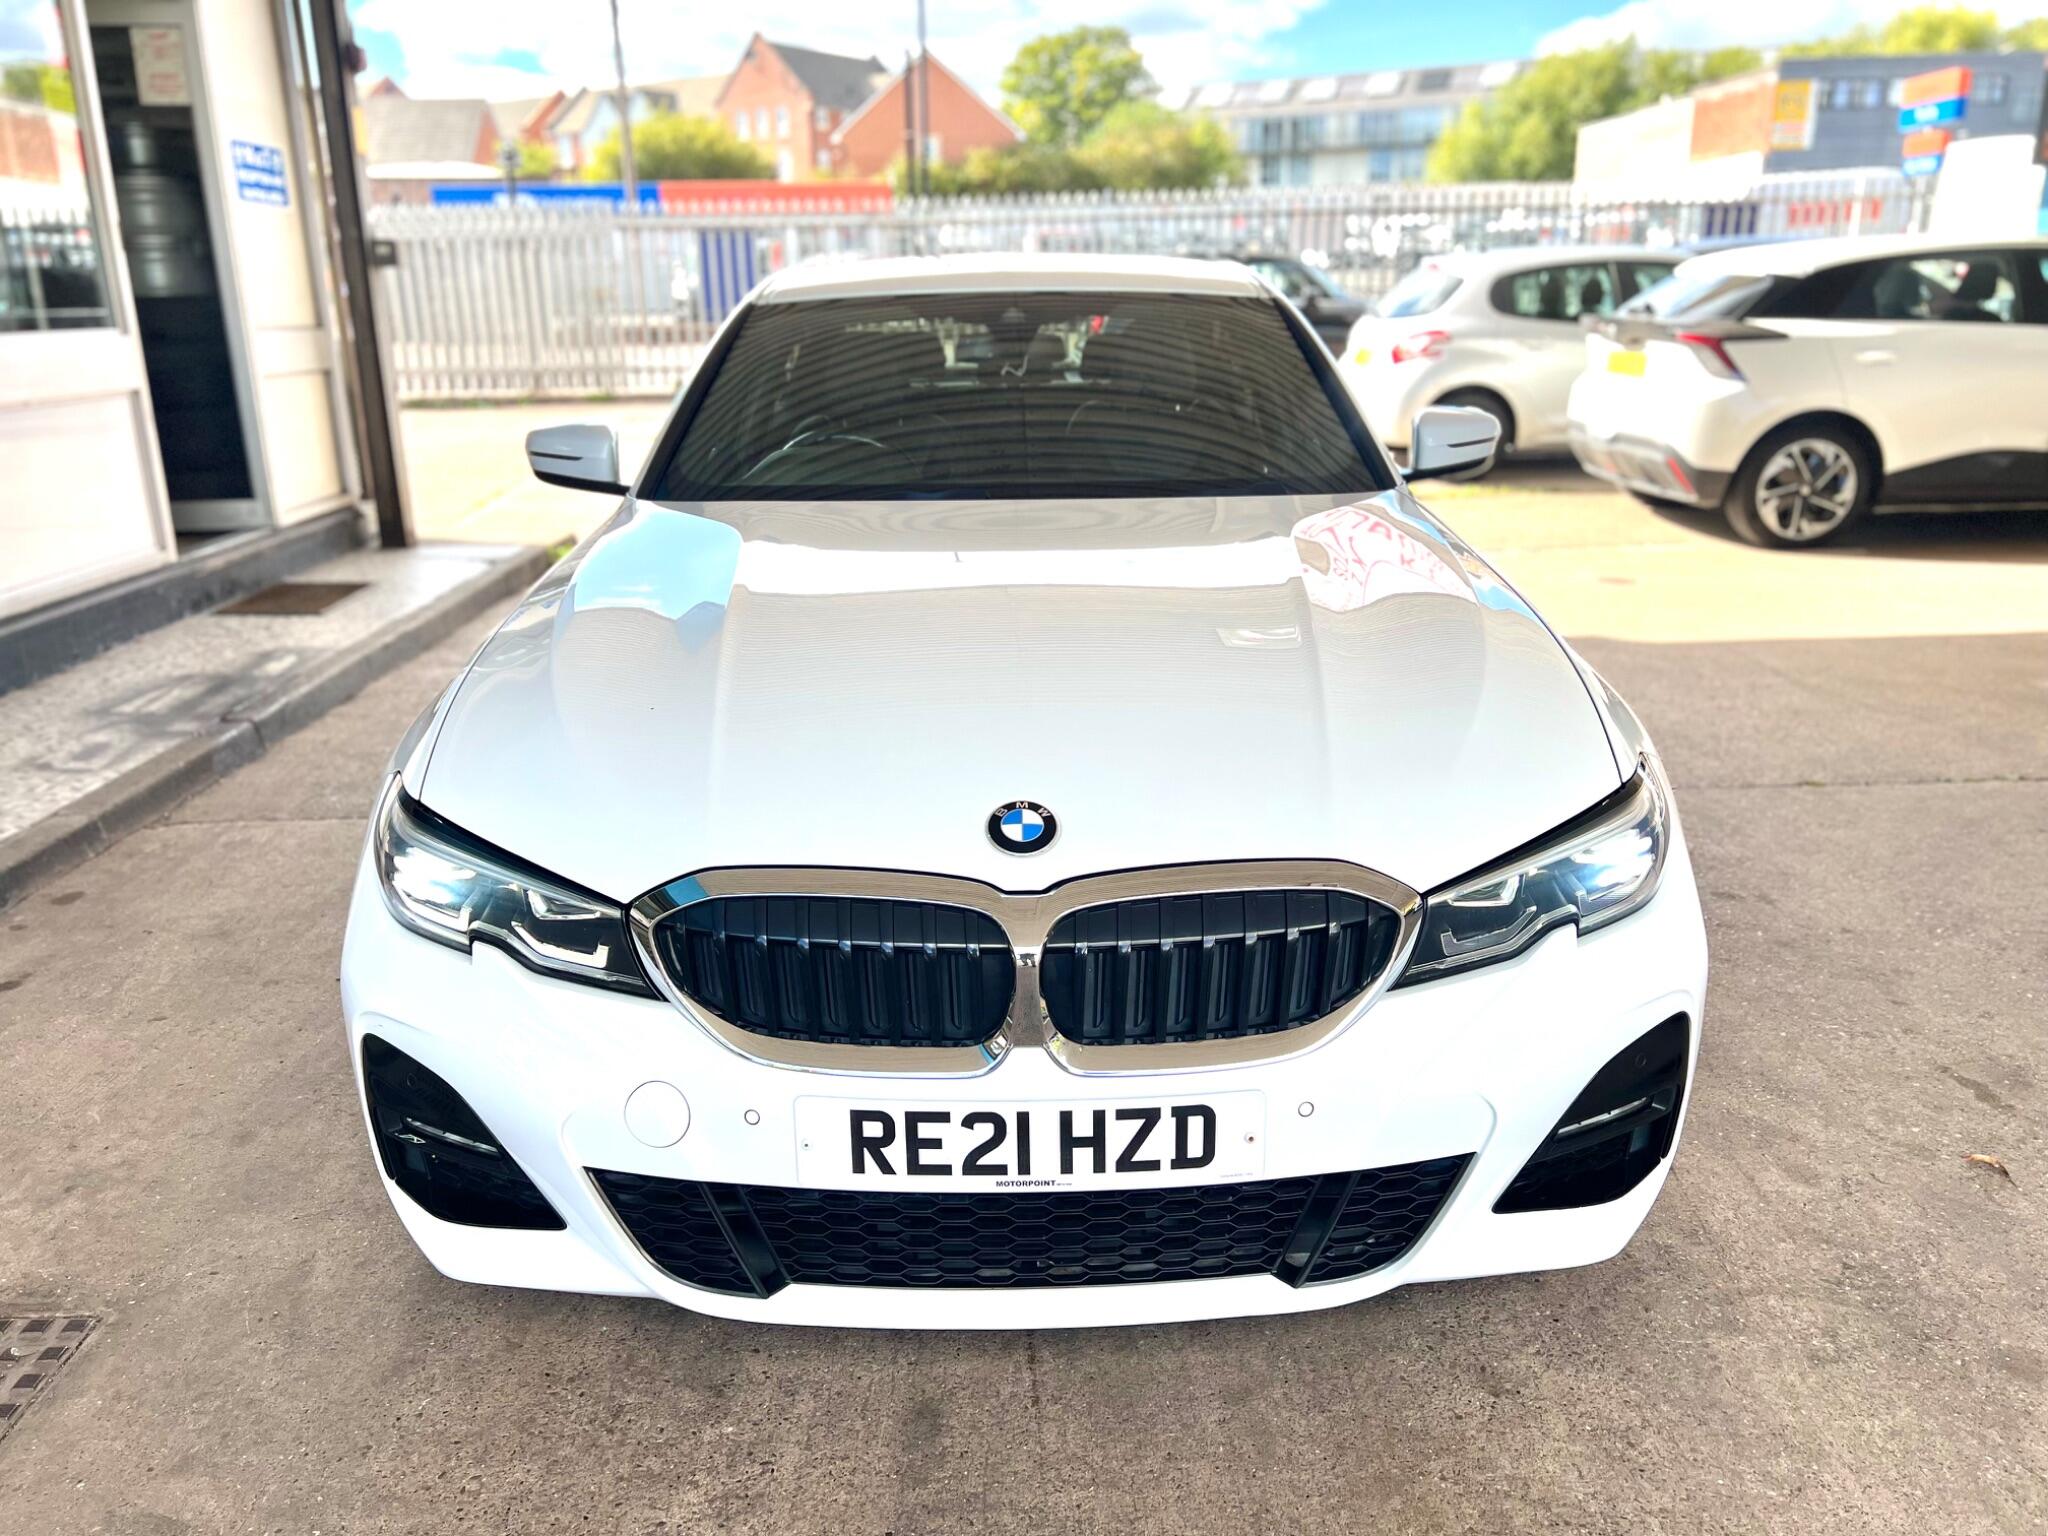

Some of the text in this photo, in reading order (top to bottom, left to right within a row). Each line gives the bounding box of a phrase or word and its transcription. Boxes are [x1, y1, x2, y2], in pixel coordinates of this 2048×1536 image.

[994, 801, 1051, 817] BMW
[849, 1104, 1217, 1176] RE21 HZD
